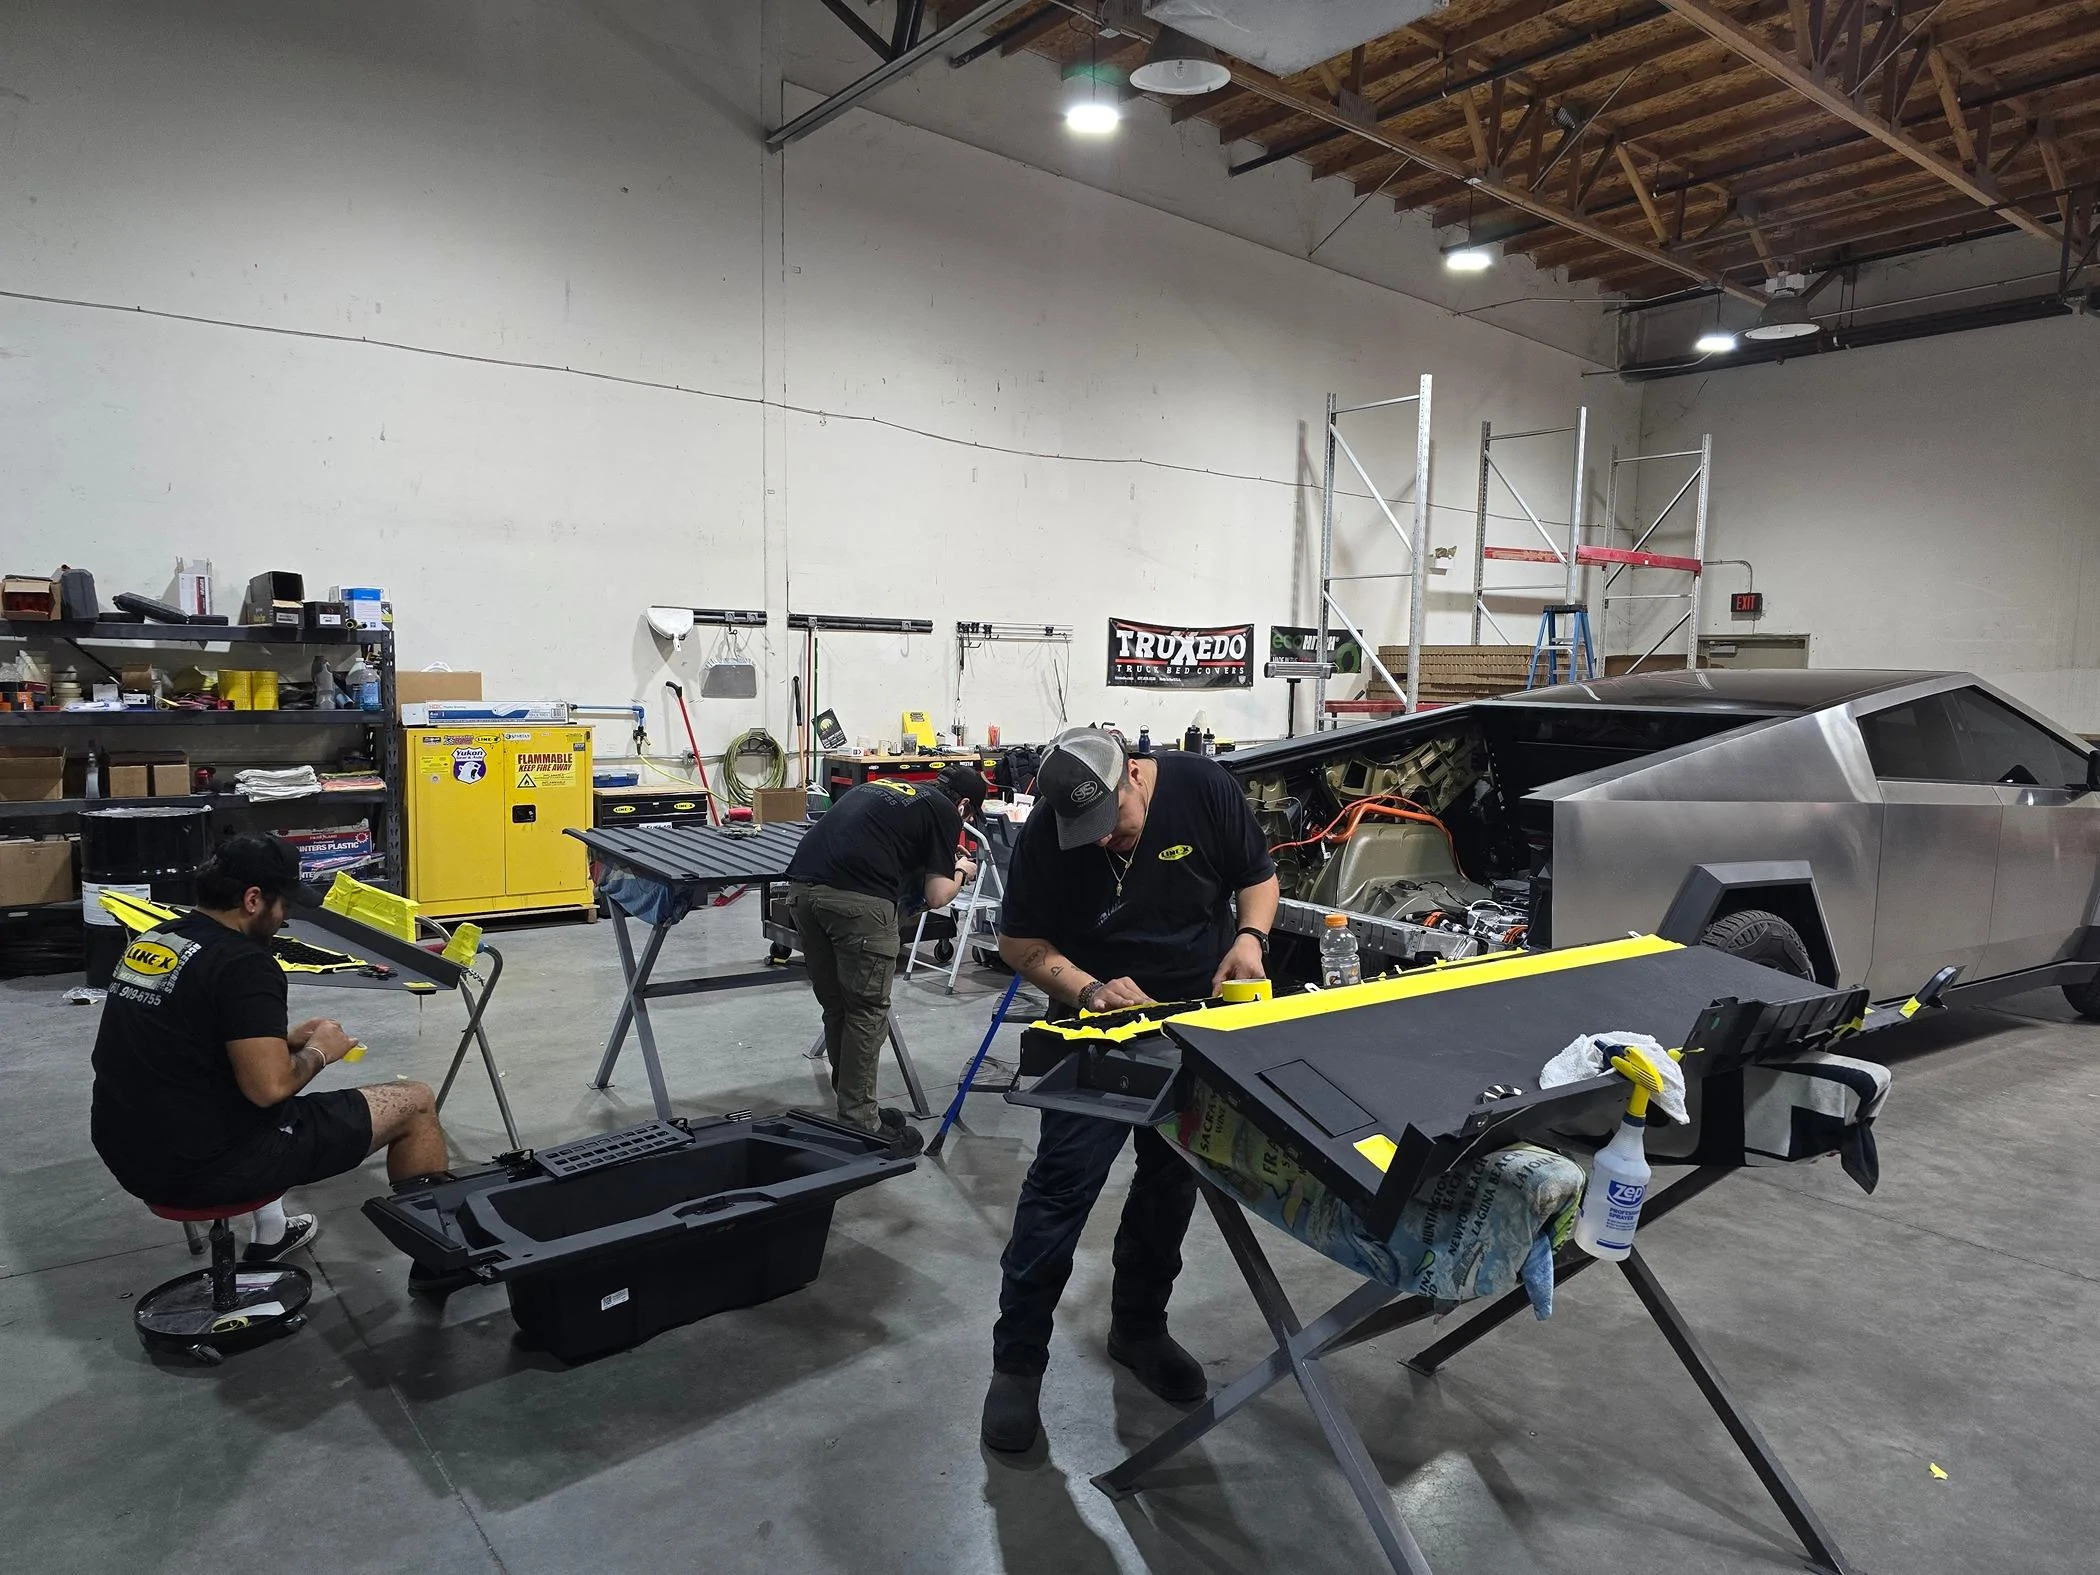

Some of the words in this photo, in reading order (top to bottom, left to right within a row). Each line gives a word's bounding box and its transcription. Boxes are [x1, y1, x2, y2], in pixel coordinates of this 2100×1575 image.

[1736, 595, 1755, 610] EXIT
[1116, 630, 1246, 665] TRUXEDO
[1116, 665, 1160, 673] TRUCK
[1166, 666, 1190, 675] BED
[1197, 667, 1245, 675] COVERS
[456, 749, 483, 757] Yukon
[517, 753, 573, 765] FLAMMABLE
[518, 764, 536, 772] KEEP
[536, 763, 551, 772] FIRE
[551, 763, 572, 771] AWAY
[328, 841, 360, 851] PLASTIC
[126, 946, 175, 970] LINE-X
[1464, 1156, 1490, 1201] BEACH
[1511, 1170, 1526, 1191] LA
[1471, 1187, 1498, 1238] LAGUNA
[1492, 1151, 1525, 1186] BEACH
